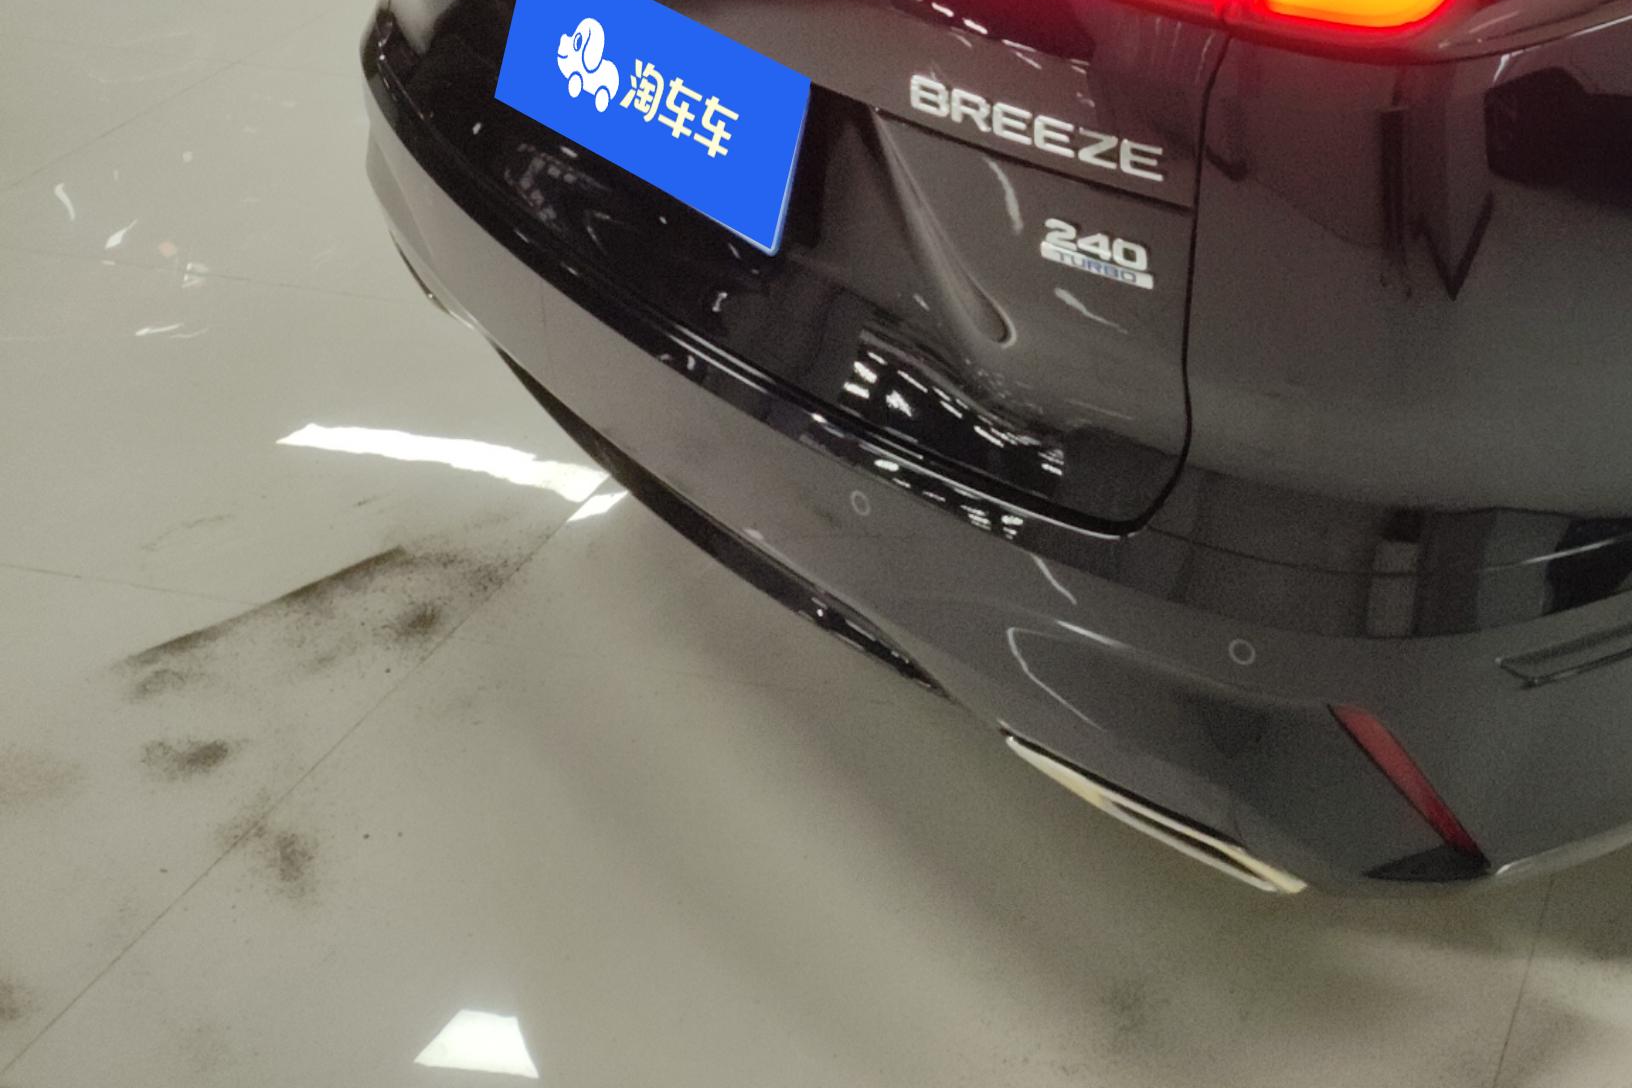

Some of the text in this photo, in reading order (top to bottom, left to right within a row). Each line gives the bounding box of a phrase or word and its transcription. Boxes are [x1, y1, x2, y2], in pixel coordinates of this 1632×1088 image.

[910, 74, 1164, 182] BREEZE
[1044, 217, 1148, 271] 240
[1056, 251, 1138, 284] TURBO
